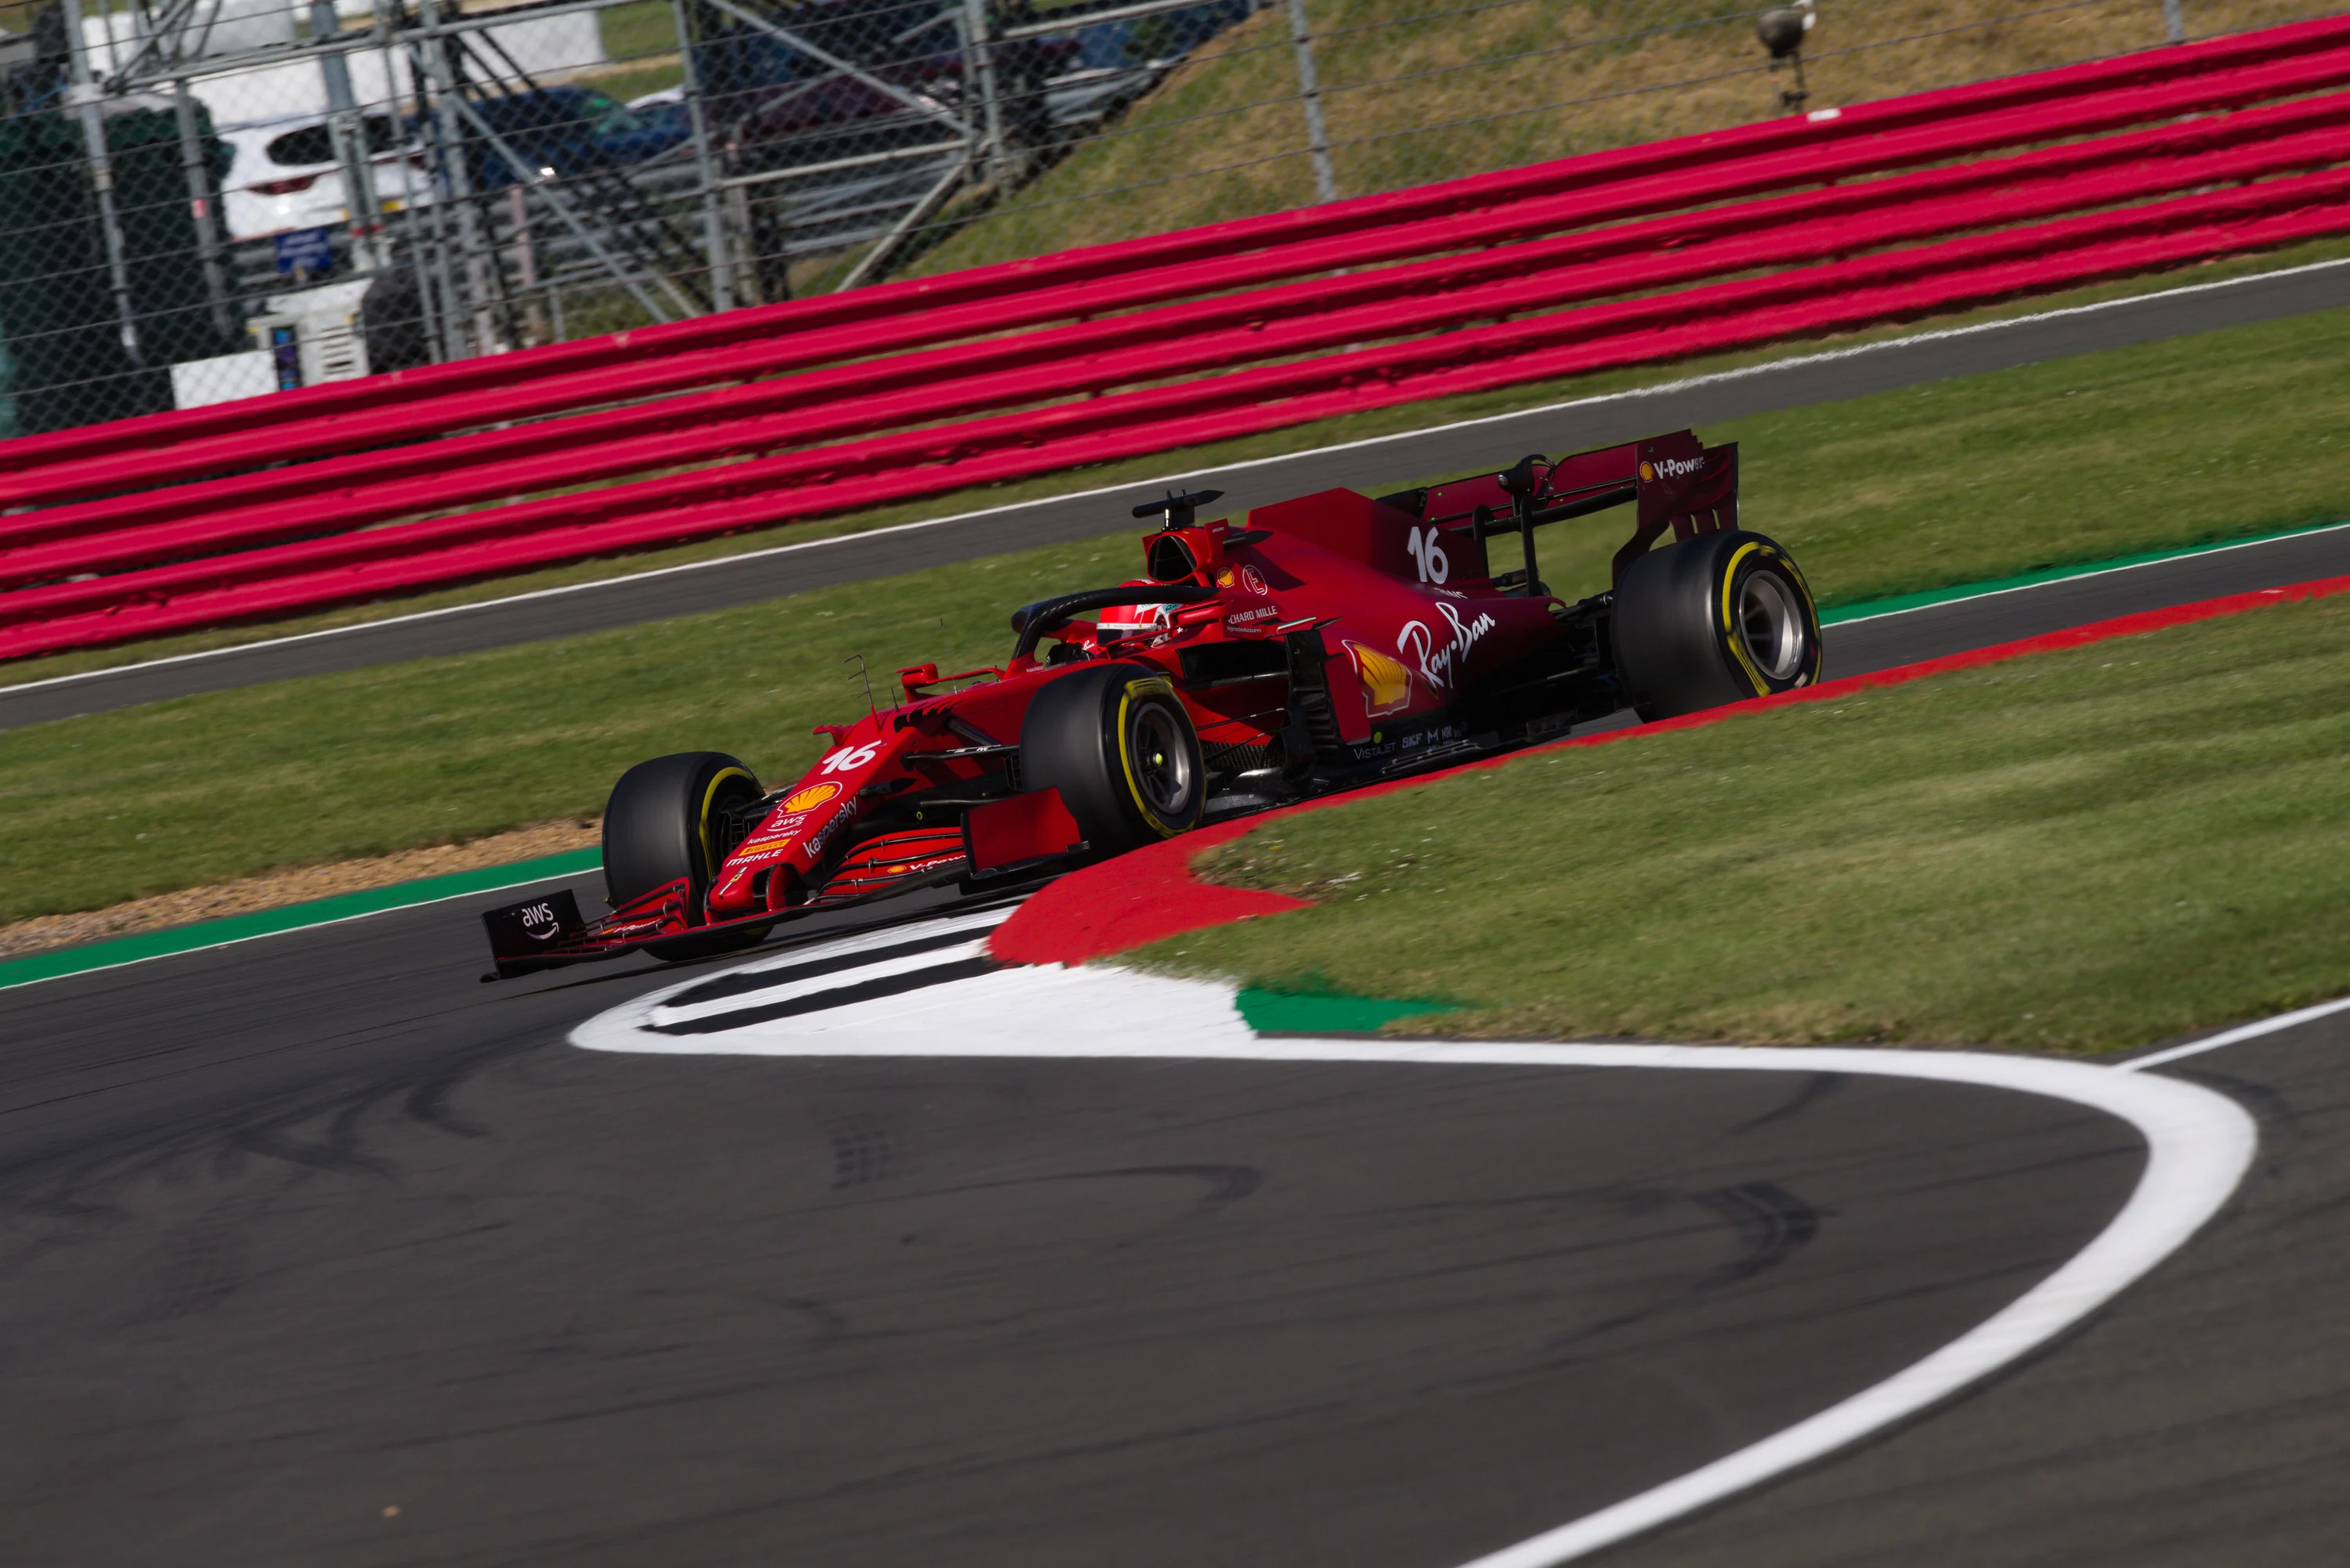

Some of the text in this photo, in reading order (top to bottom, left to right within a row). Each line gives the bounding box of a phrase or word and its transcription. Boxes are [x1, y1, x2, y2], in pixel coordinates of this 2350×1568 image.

[1407, 526, 1448, 584] 16
[1227, 605, 1278, 624] CHARD MILLE
[1401, 733, 1423, 750] SKF
[820, 739, 882, 775] 16
[771, 814, 808, 829] aws
[803, 796, 858, 858] kaspersky
[725, 849, 784, 868] MAHLE
[521, 902, 554, 927] aws
